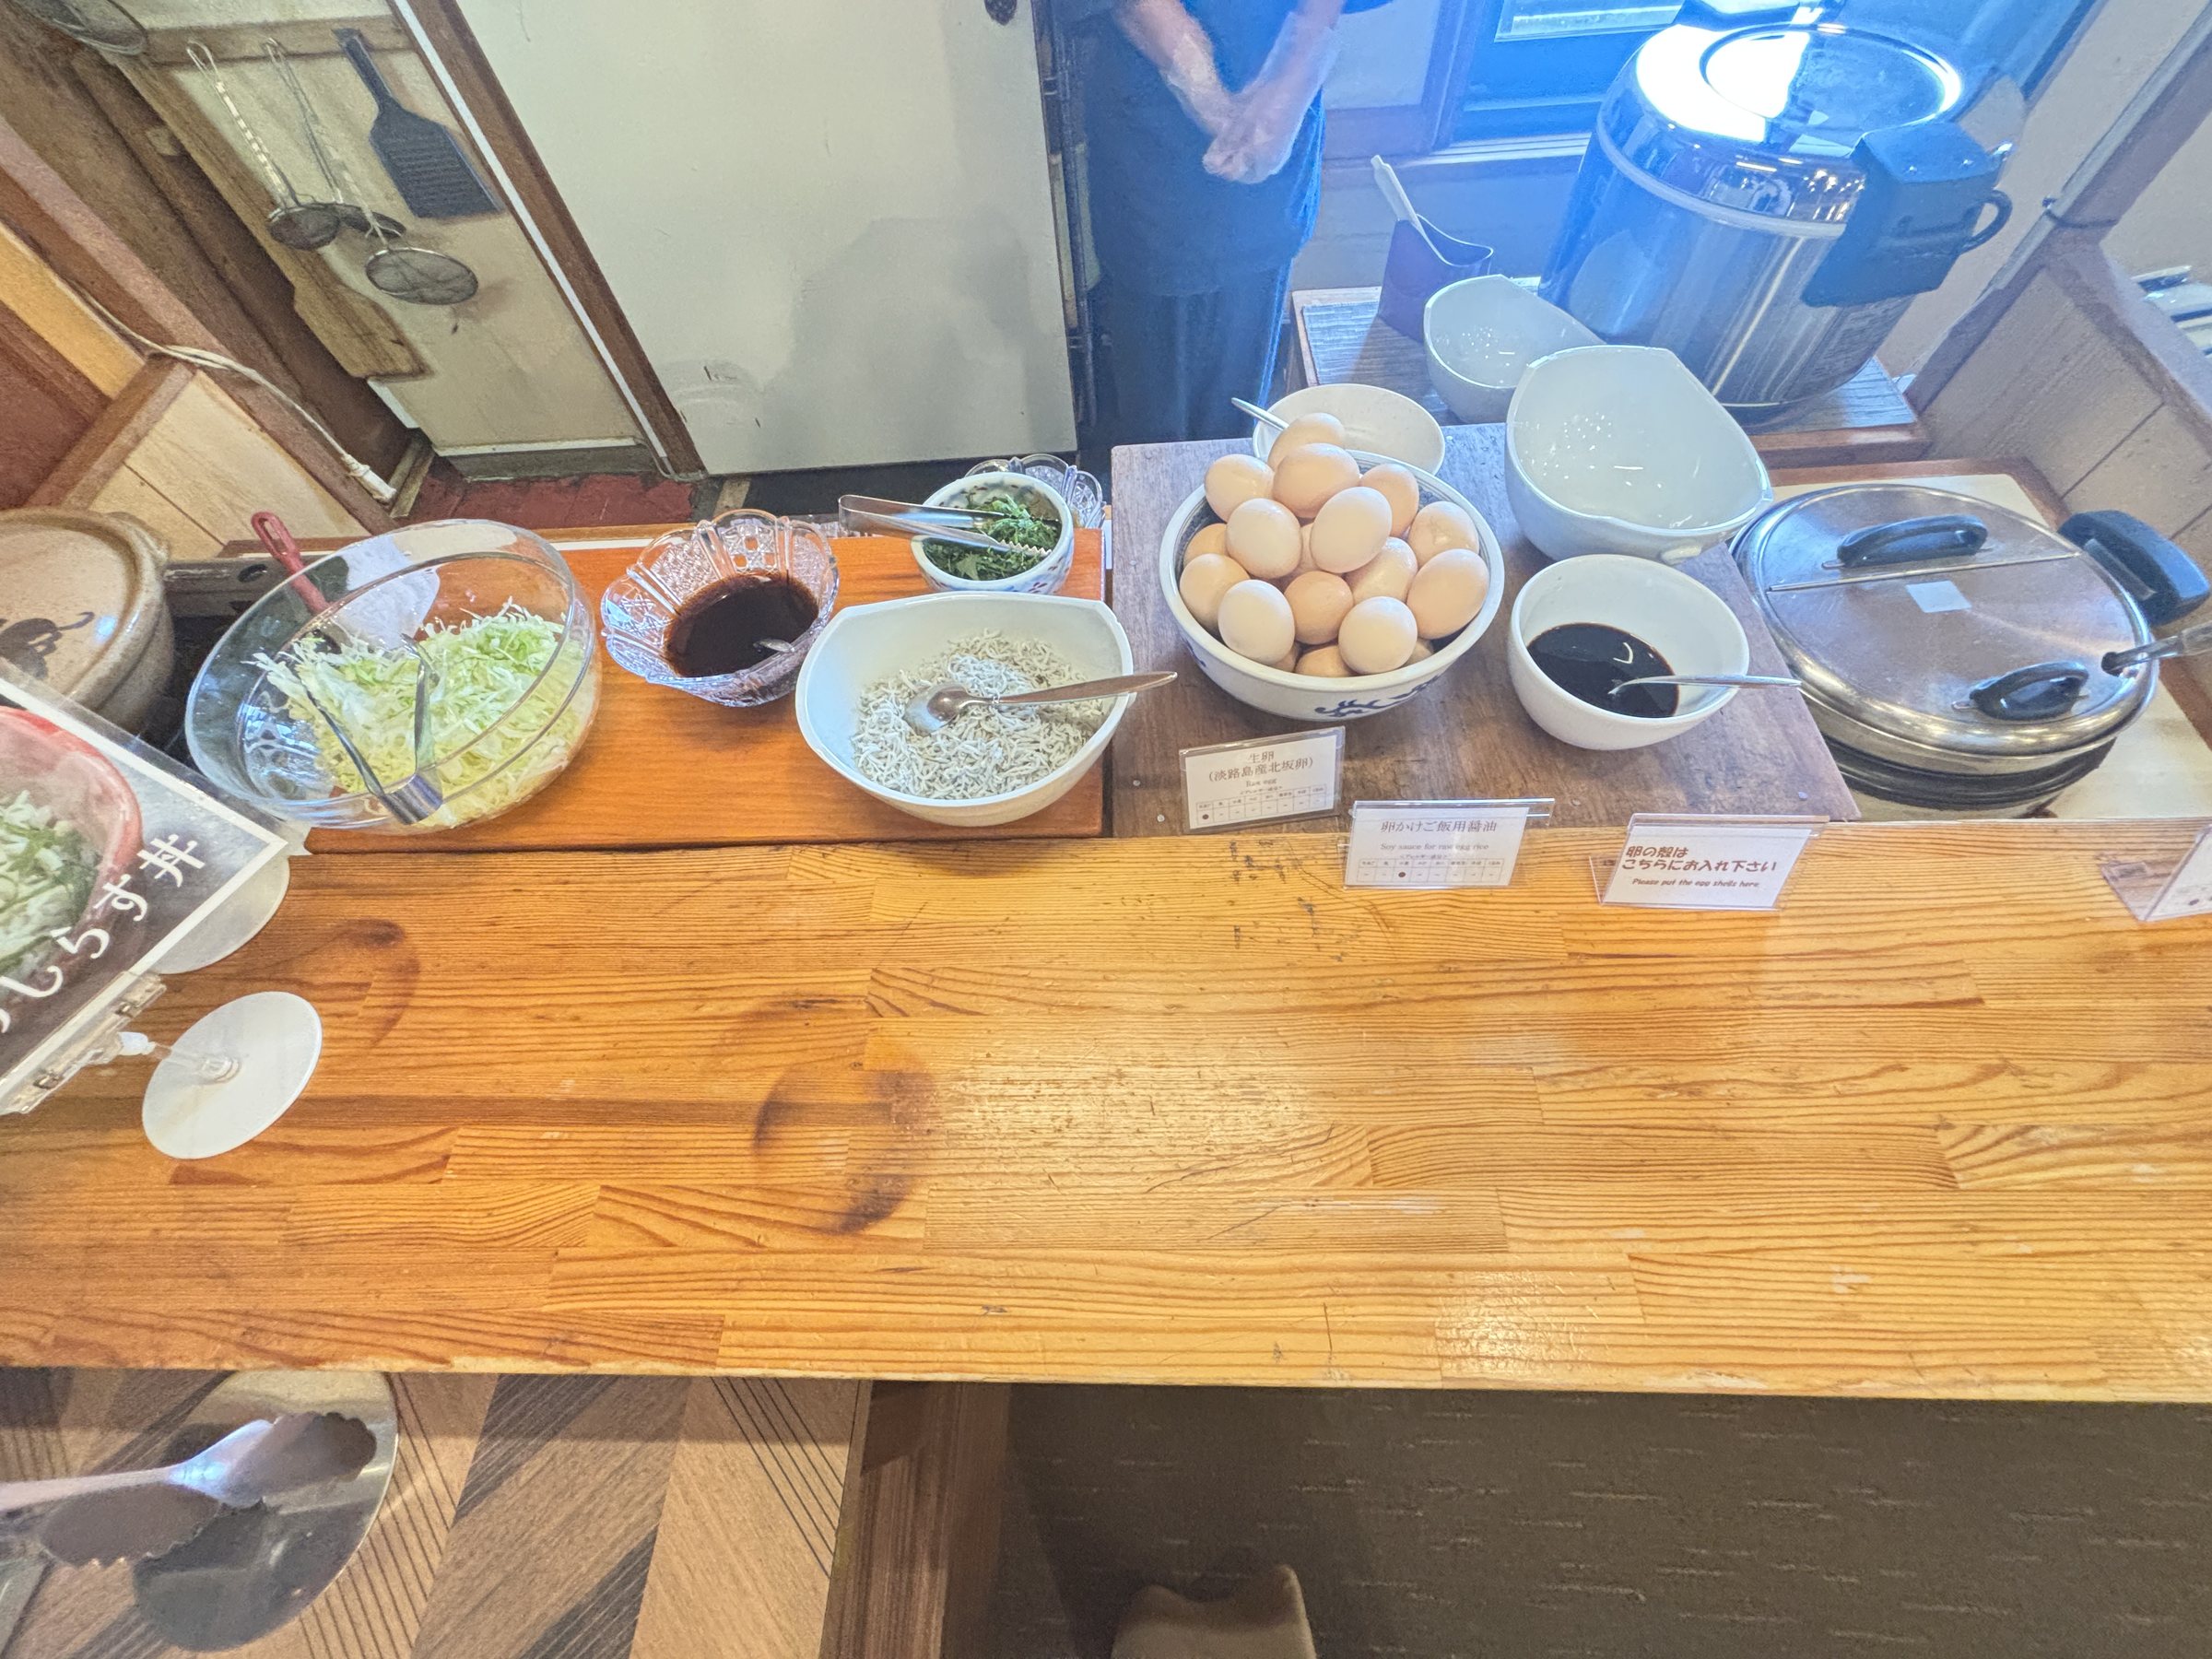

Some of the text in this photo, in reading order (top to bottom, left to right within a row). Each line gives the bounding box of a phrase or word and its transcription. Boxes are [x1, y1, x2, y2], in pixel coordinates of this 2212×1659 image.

[1249, 750, 1275, 764] 生卵
[1380, 819, 1497, 833] 卵かけご飯用醤油
[1380, 842, 1395, 852] Soy
[1625, 845, 1688, 858] 卵の殻は
[1621, 859, 1777, 873] こちらにお入れ下さい
[1632, 877, 1659, 886] Please
[1712, 879, 1737, 888] shells
[0, 833, 206, 1034] しらす丼
